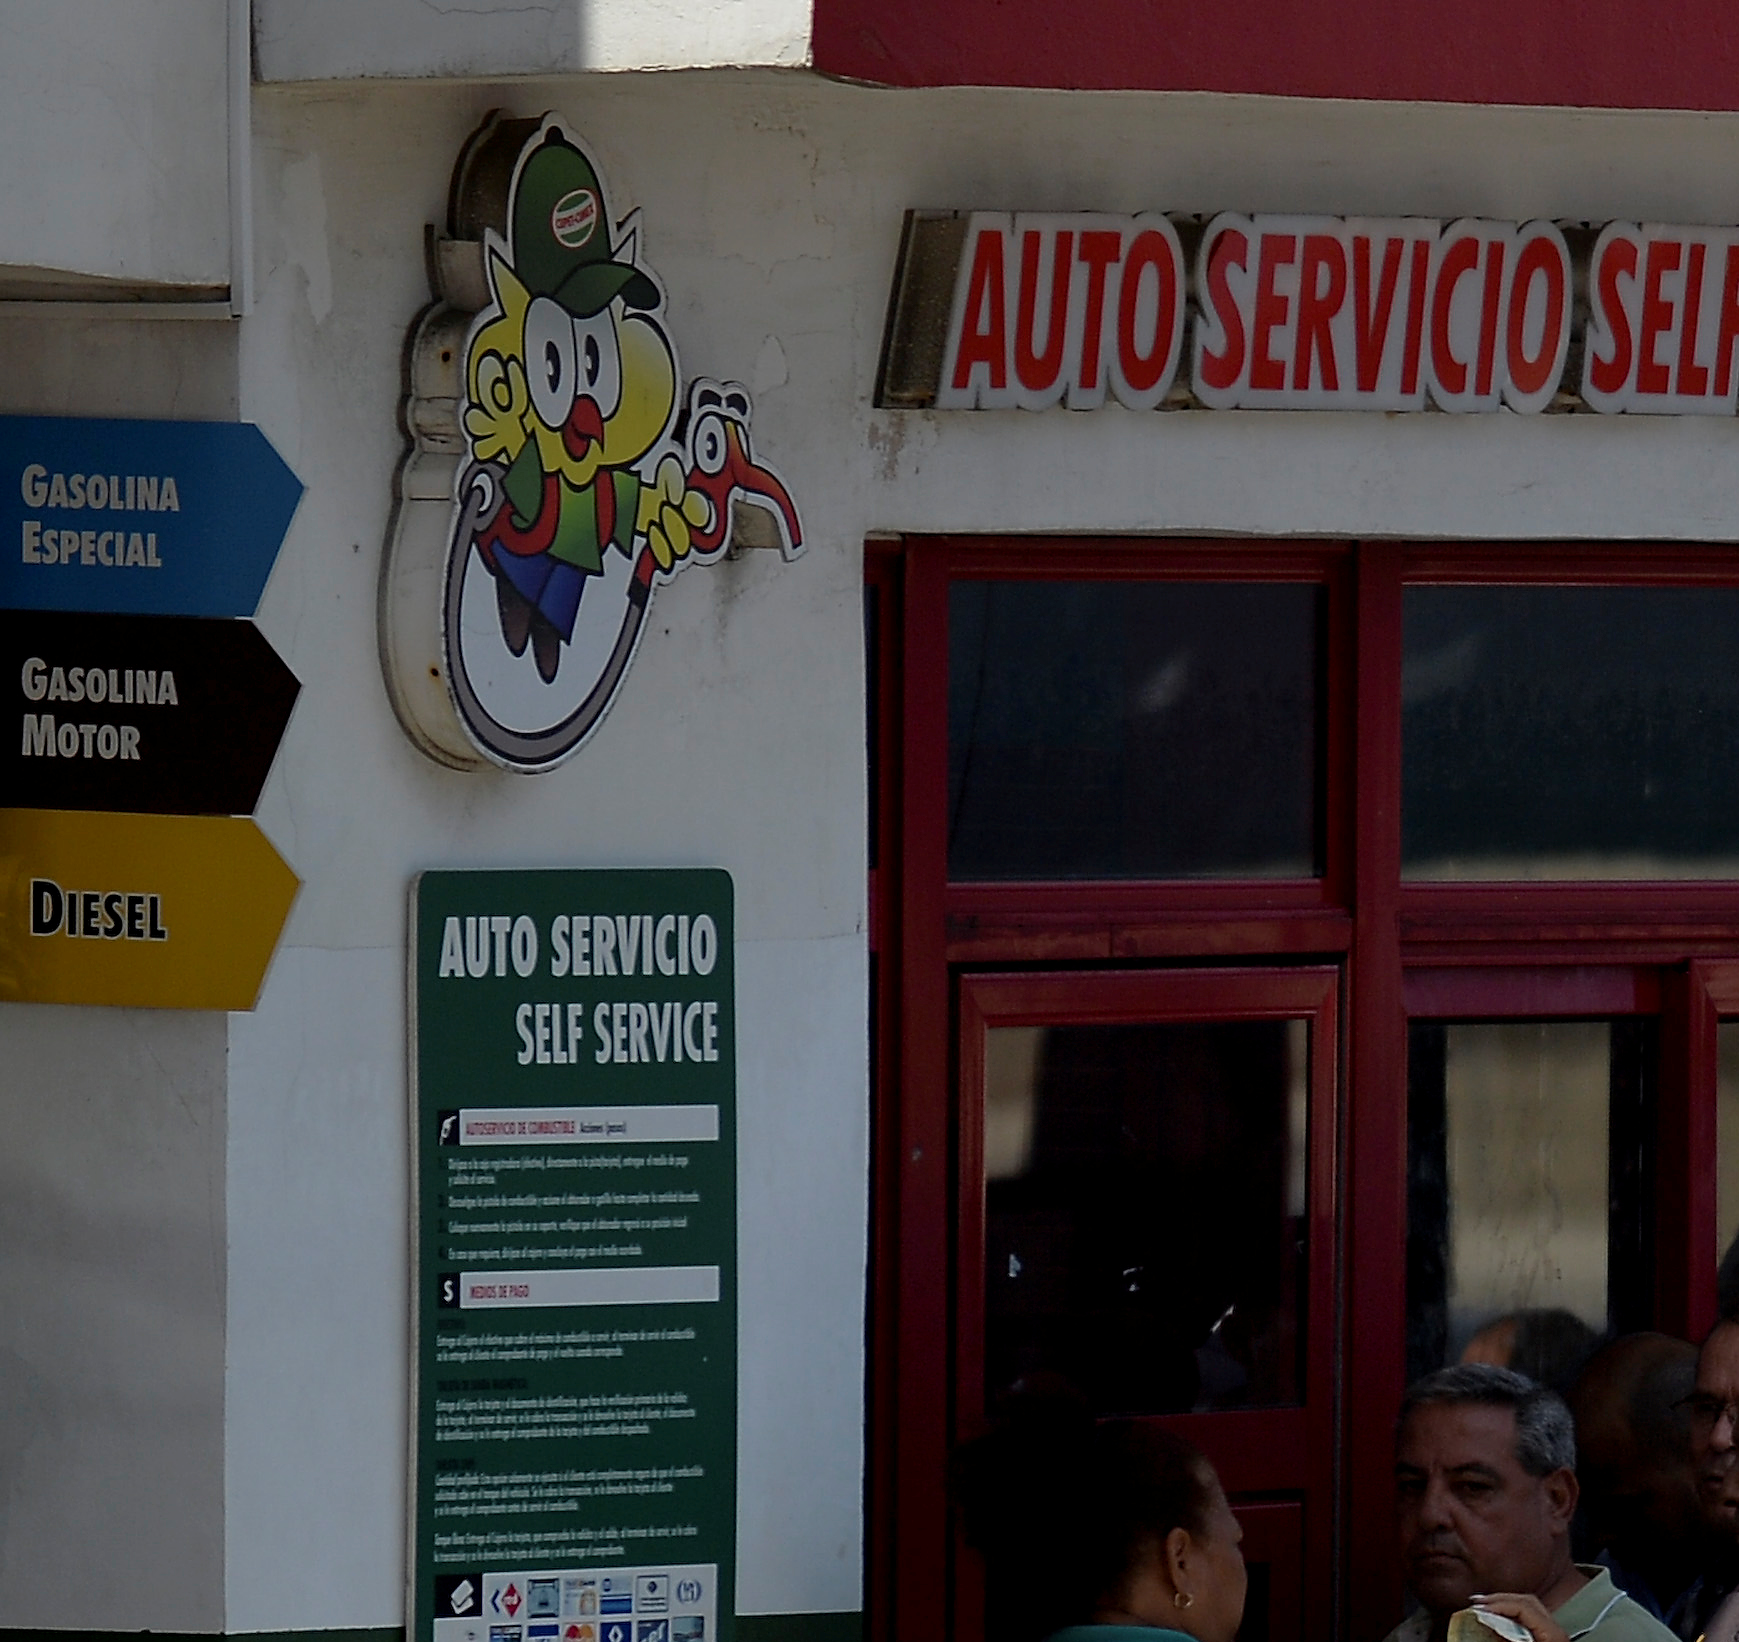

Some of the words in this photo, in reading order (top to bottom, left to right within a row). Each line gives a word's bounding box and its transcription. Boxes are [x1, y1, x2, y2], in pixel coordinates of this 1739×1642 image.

[952, 229, 1179, 393] AUTO
[1198, 228, 1568, 397] SERVICIO
[21, 463, 181, 512] GASOLINA
[21, 521, 162, 568] ESPECIAL
[21, 657, 180, 706] GASOLINA
[21, 714, 141, 761] MOTOR
[30, 878, 168, 940] DIESEL
[438, 915, 538, 978] AUTO
[550, 914, 718, 977] SERVICIO
[515, 1003, 584, 1065] SELF
[593, 1002, 719, 1064] SERVICE
[470, 1285, 496, 1299] MEDIOS
[498, 1285, 507, 1299] DE
[509, 1284, 530, 1298] PAGO
